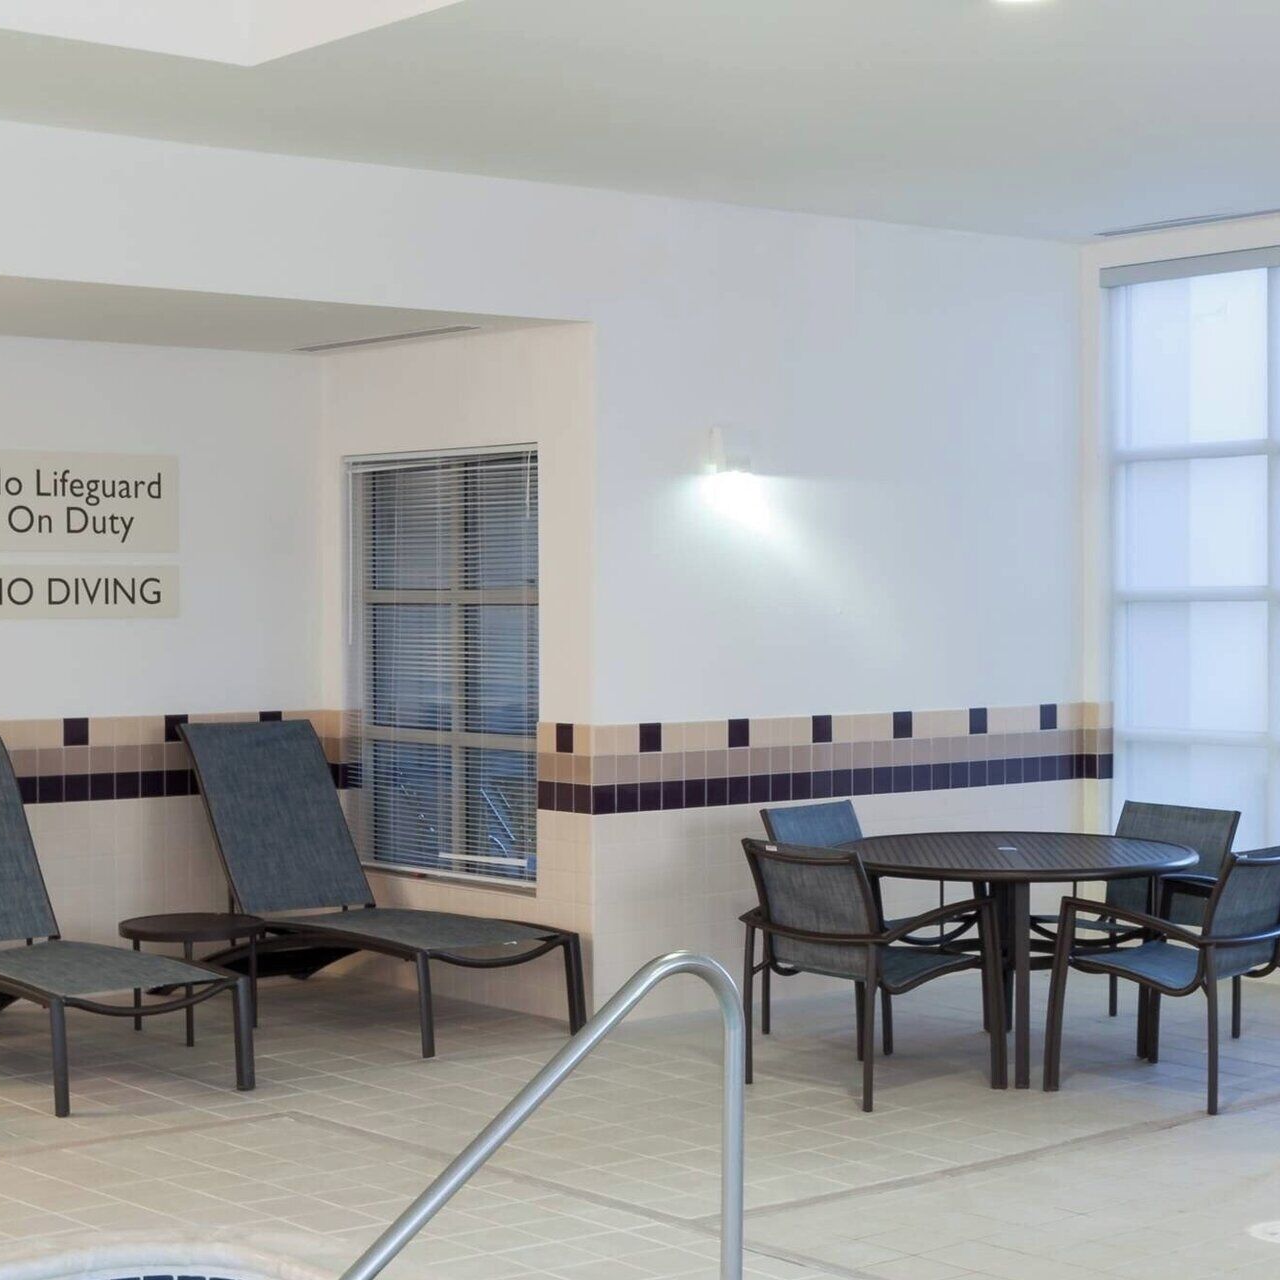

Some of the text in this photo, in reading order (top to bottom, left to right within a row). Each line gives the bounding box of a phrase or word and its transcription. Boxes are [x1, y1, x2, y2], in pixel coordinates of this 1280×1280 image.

[36, 469, 162, 506] Lifeguard
[8, 505, 134, 543] On Duty
[48, 577, 162, 605] DIVING
